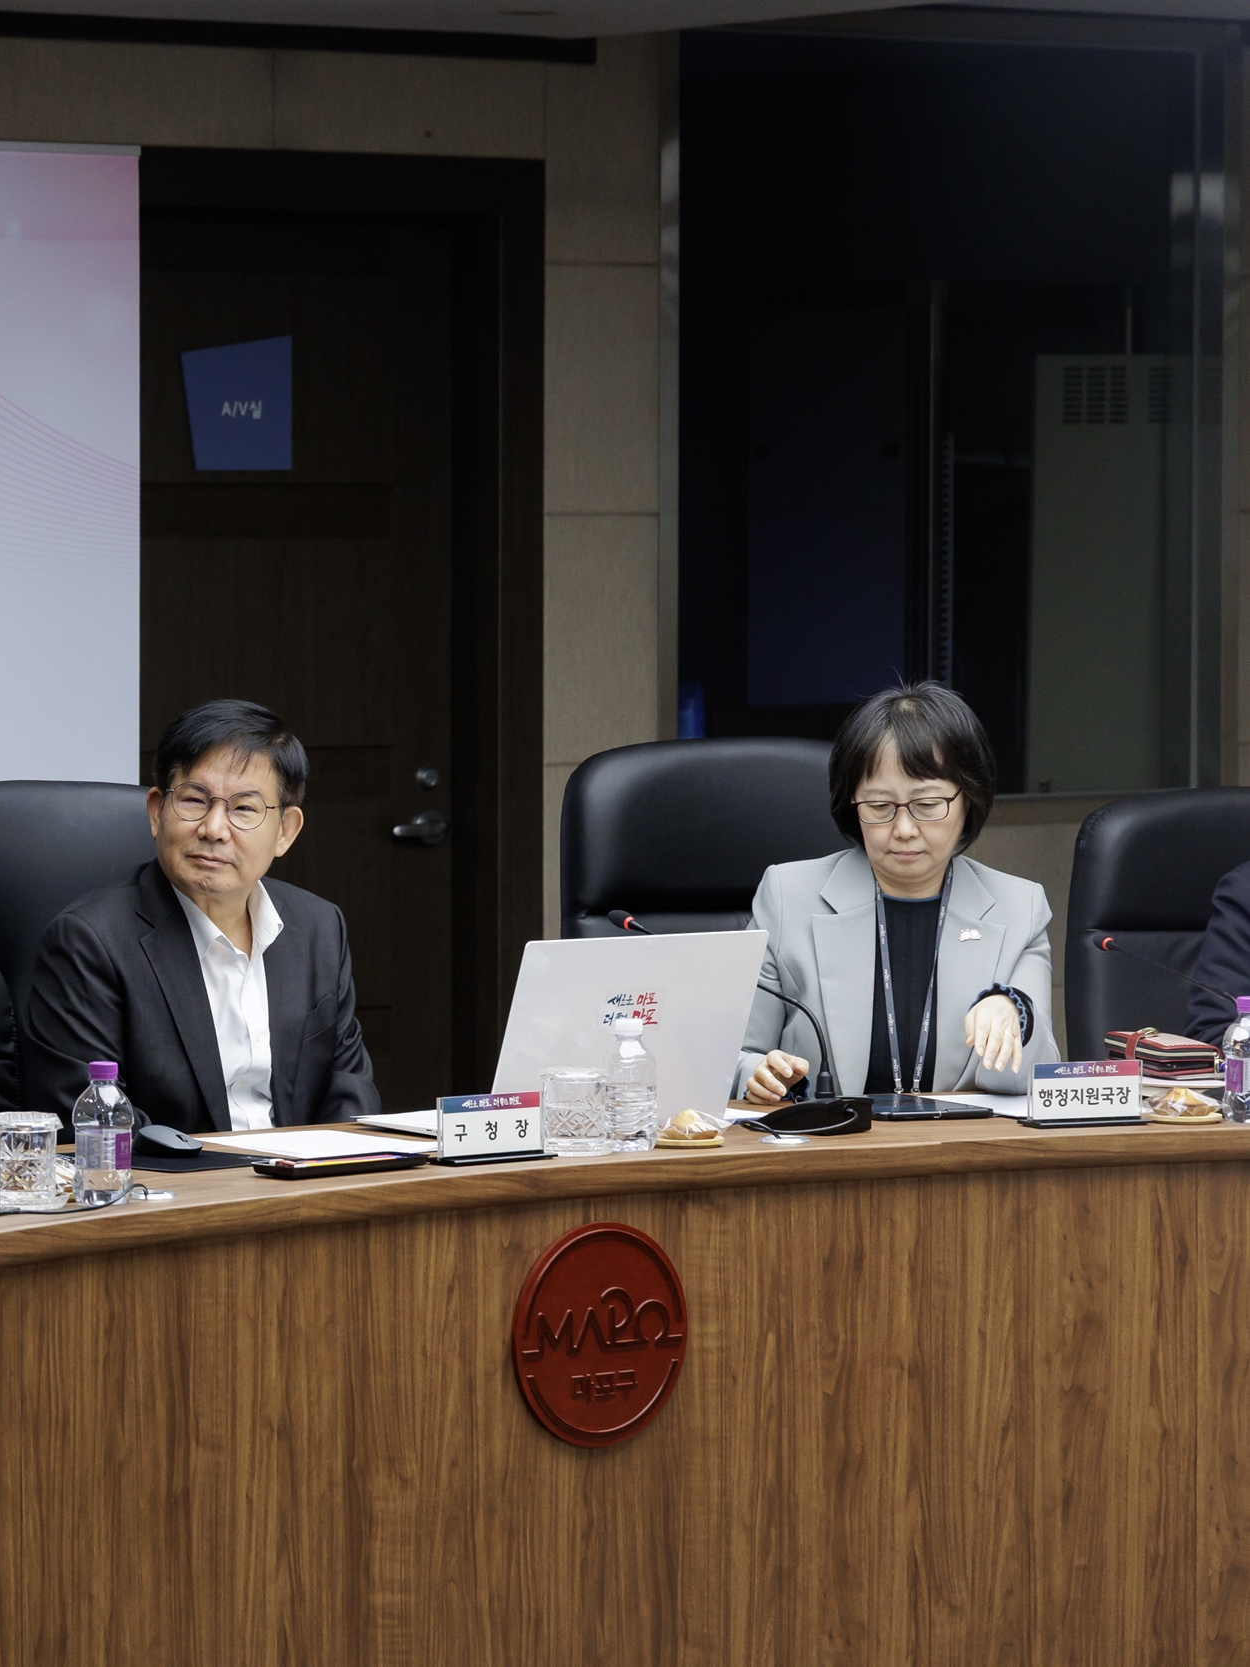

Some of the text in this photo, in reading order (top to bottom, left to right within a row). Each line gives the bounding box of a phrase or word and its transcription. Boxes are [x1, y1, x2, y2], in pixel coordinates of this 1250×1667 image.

[636, 992, 658, 1006] 마포
[1039, 1087, 1131, 1108] 행정지원국장
[521, 1287, 683, 1361] MAPO
[571, 1369, 639, 1405] 마포구
